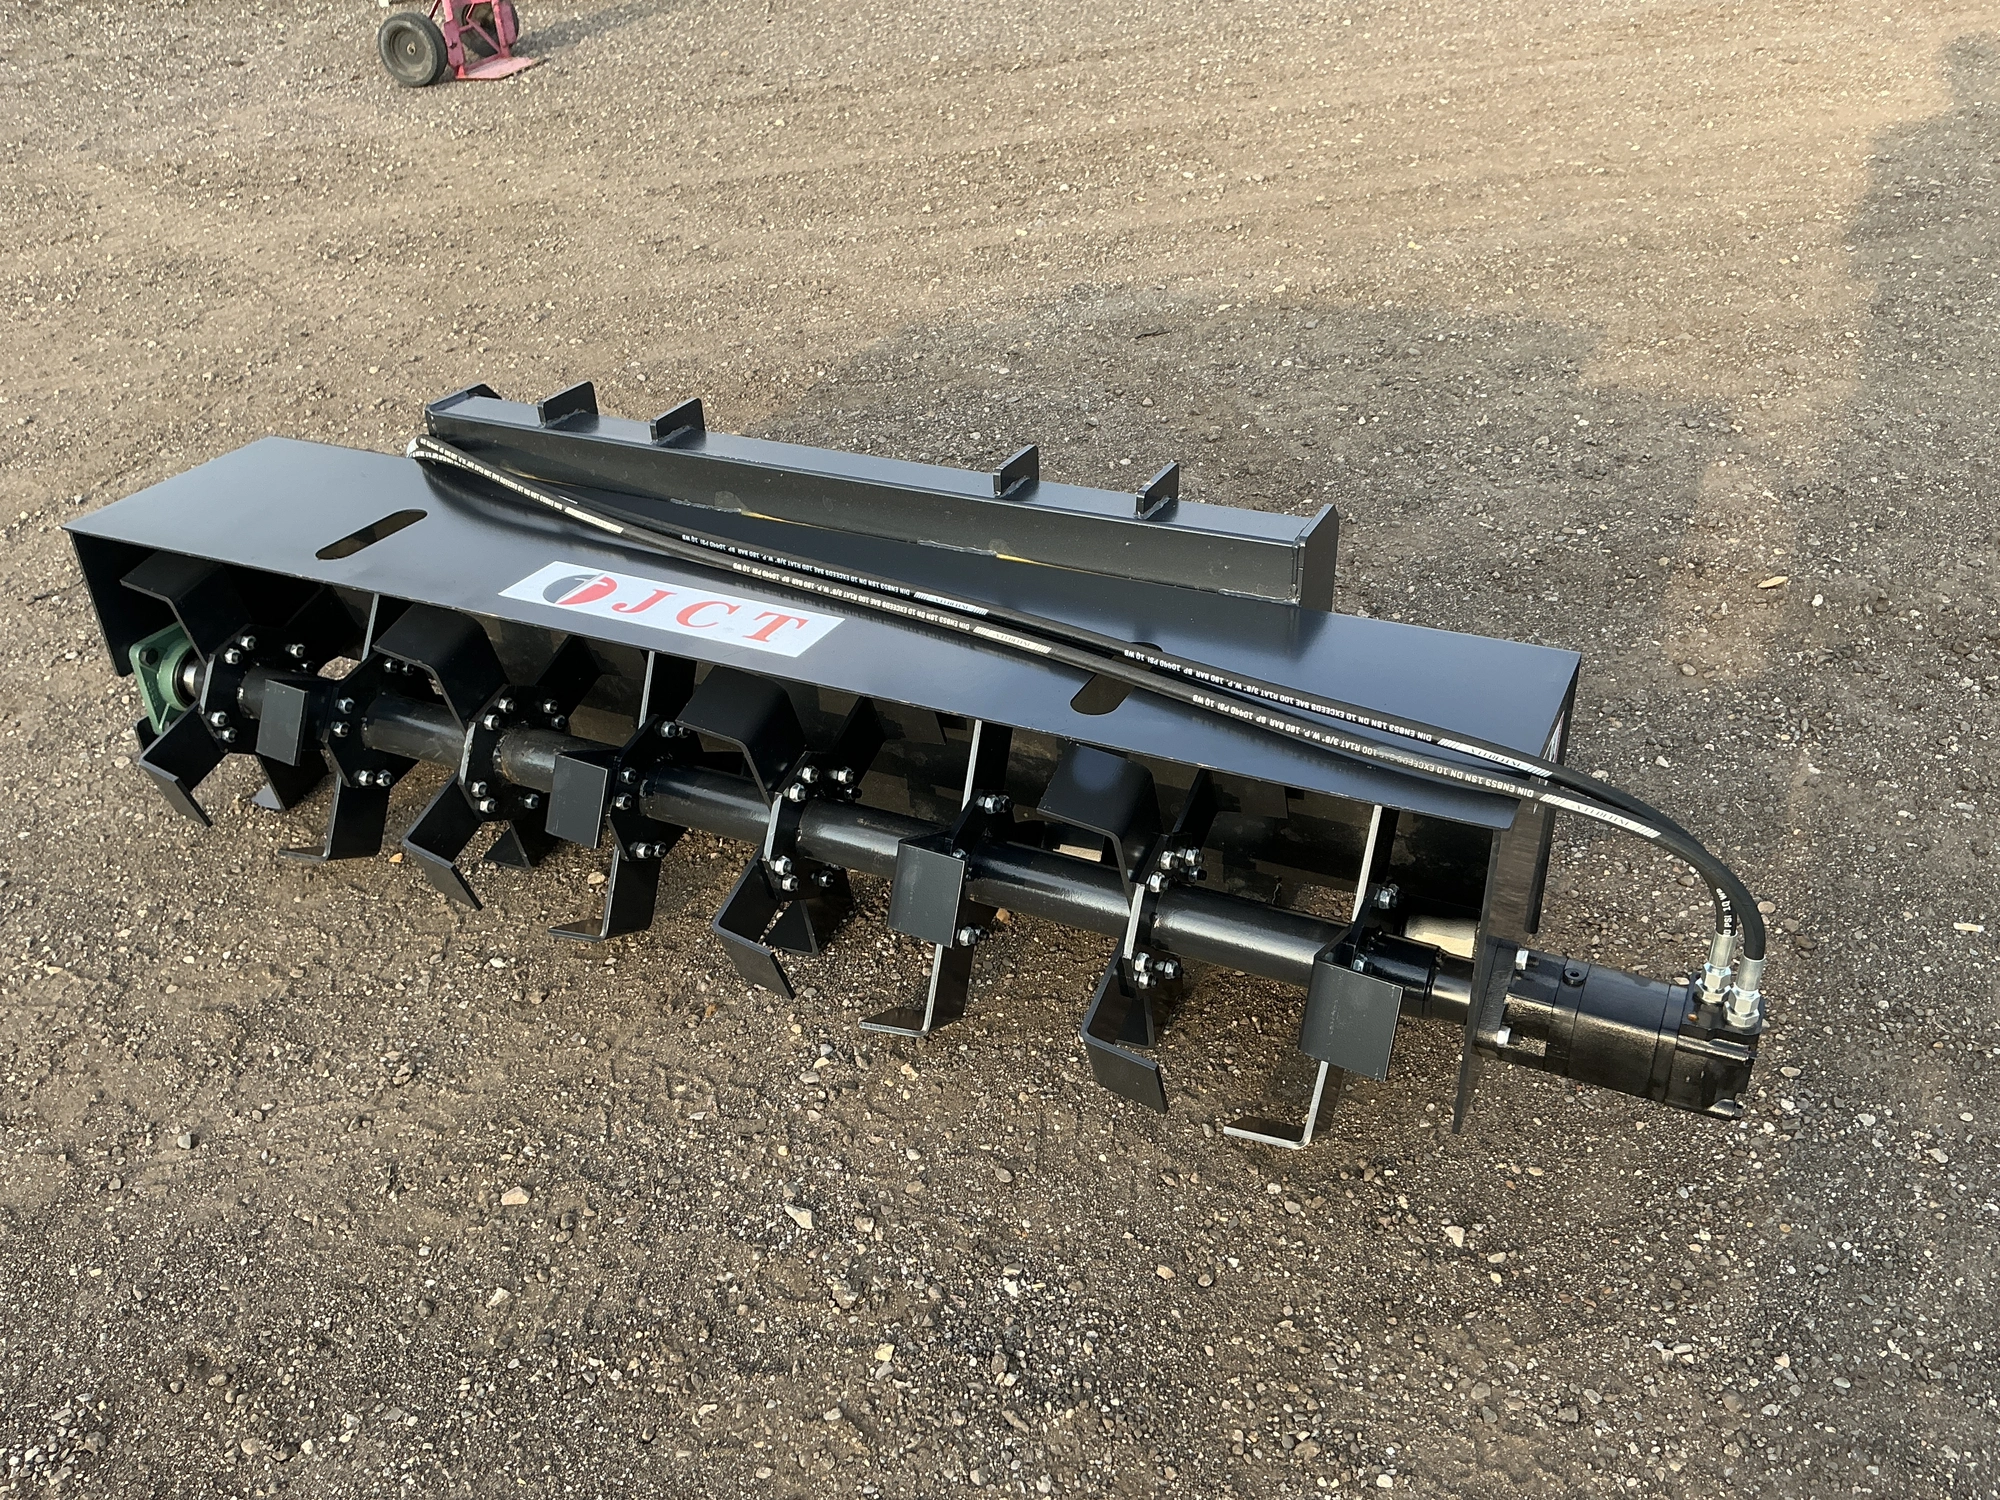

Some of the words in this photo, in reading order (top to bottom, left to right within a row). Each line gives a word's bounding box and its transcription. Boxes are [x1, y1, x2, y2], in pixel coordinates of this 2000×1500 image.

[611, 588, 809, 643] JCT
[1147, 656, 1159, 665] PSI
[1195, 670, 1210, 680] BAR
[1210, 674, 1224, 684] 180
[1260, 689, 1278, 700] R1AT
[1279, 694, 1294, 704] 100
[1217, 702, 1230, 712] PSI
[1295, 698, 1310, 709] SAE
[1310, 703, 1345, 718] EXCEEDS
[1346, 712, 1357, 721] 10
[1358, 715, 1370, 725] DN
[1269, 718, 1285, 729] BAR
[1285, 723, 1301, 734] 180
[1371, 719, 1388, 729] 1SN
[1417, 731, 1432, 741] DIN
[1340, 739, 1361, 751] R1AT
[1361, 745, 1379, 756] 100
[1436, 766, 1449, 775] 10
[1450, 769, 1464, 779] DN
[1464, 773, 1484, 784] 1SN
[1516, 786, 1534, 798] DIN
[1723, 914, 1732, 927] PSI
